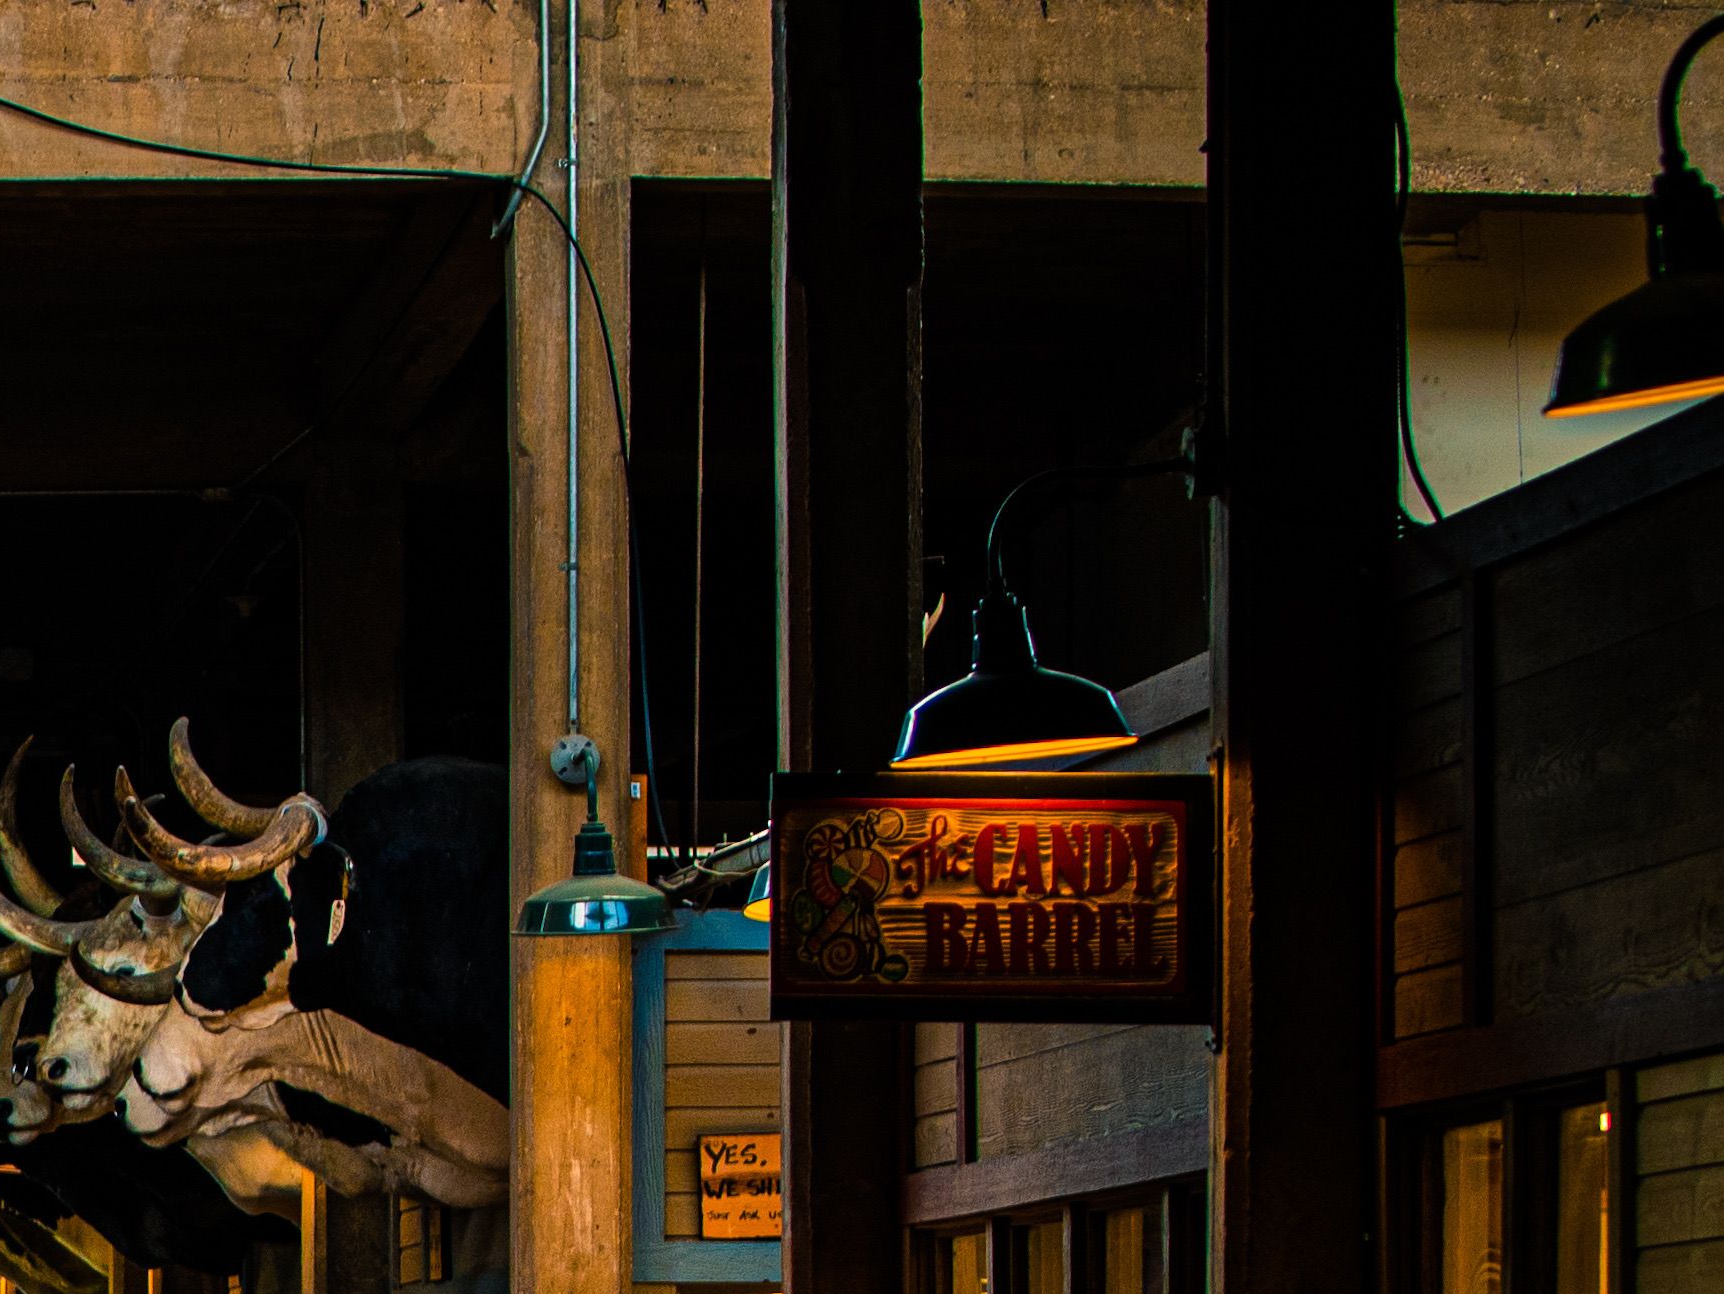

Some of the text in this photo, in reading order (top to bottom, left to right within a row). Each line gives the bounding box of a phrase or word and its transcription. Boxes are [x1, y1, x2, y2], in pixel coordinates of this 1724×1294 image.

[895, 815, 1166, 897] The CANDY
[922, 901, 1168, 976] BARREL
[704, 1142, 767, 1174] YES.
[704, 1178, 739, 1200] WE
